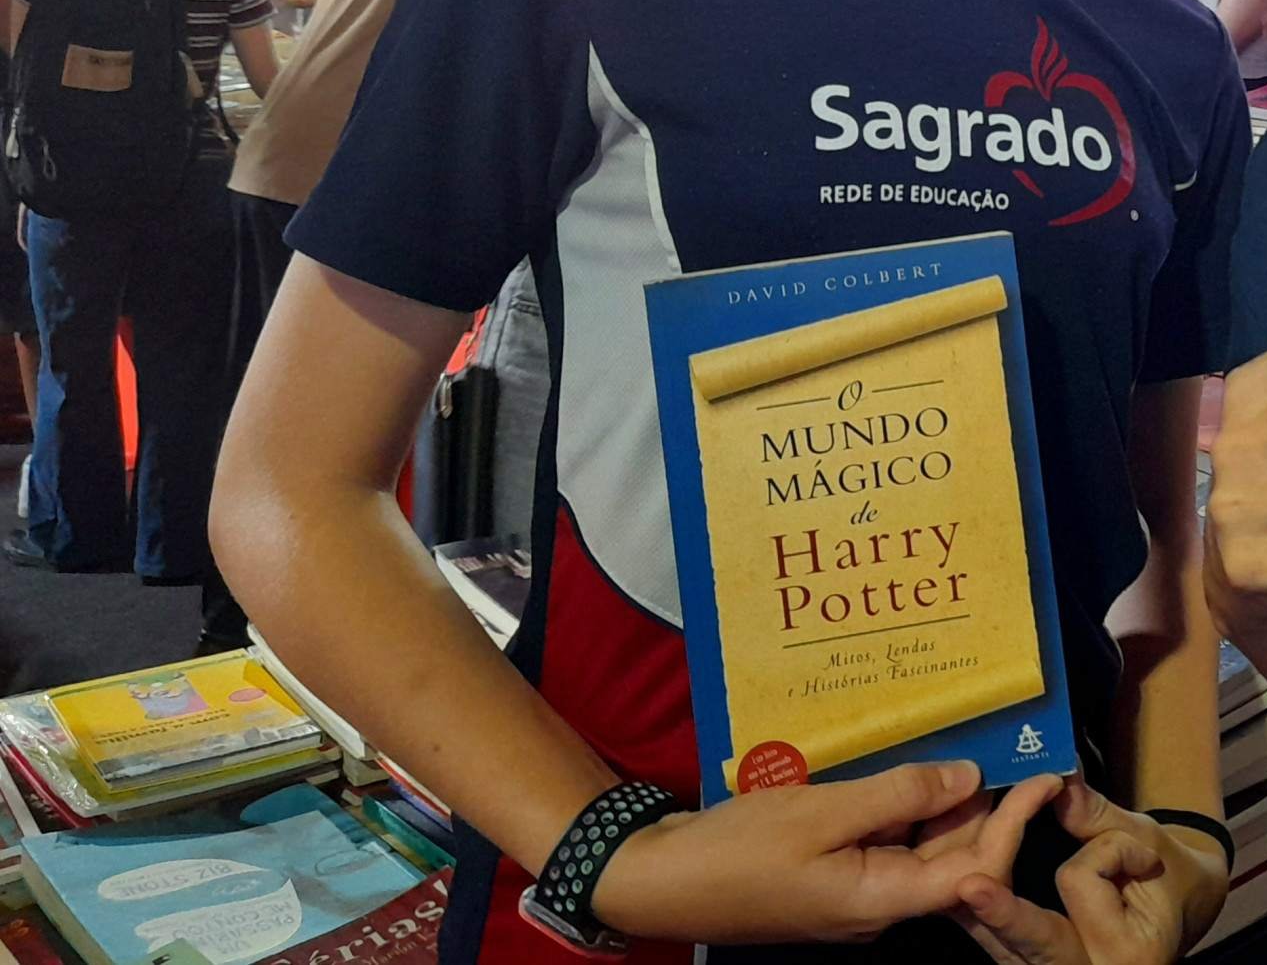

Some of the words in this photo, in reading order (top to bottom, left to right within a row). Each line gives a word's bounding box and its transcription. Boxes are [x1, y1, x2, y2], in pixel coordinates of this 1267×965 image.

[811, 85, 1112, 172] Sagrado
[820, 184, 872, 203] REDE
[880, 184, 904, 201] DE
[911, 185, 1010, 212] EDUCAÇÃO
[728, 282, 806, 304] DAVID
[825, 263, 942, 290] COLBERT
[838, 379, 863, 411] O
[761, 407, 948, 463] MUNDO
[766, 451, 951, 506] MÁGICO
[851, 500, 878, 525] de
[770, 522, 960, 580] Harry
[775, 572, 967, 631] Potter
[824, 651, 876, 670] Mitos,
[886, 637, 935, 663] Lendas
[802, 674, 879, 698] Histórias
[886, 655, 979, 680] Fascinantes
[117, 874, 189, 897] STONE
[199, 863, 232, 879] BIZ
